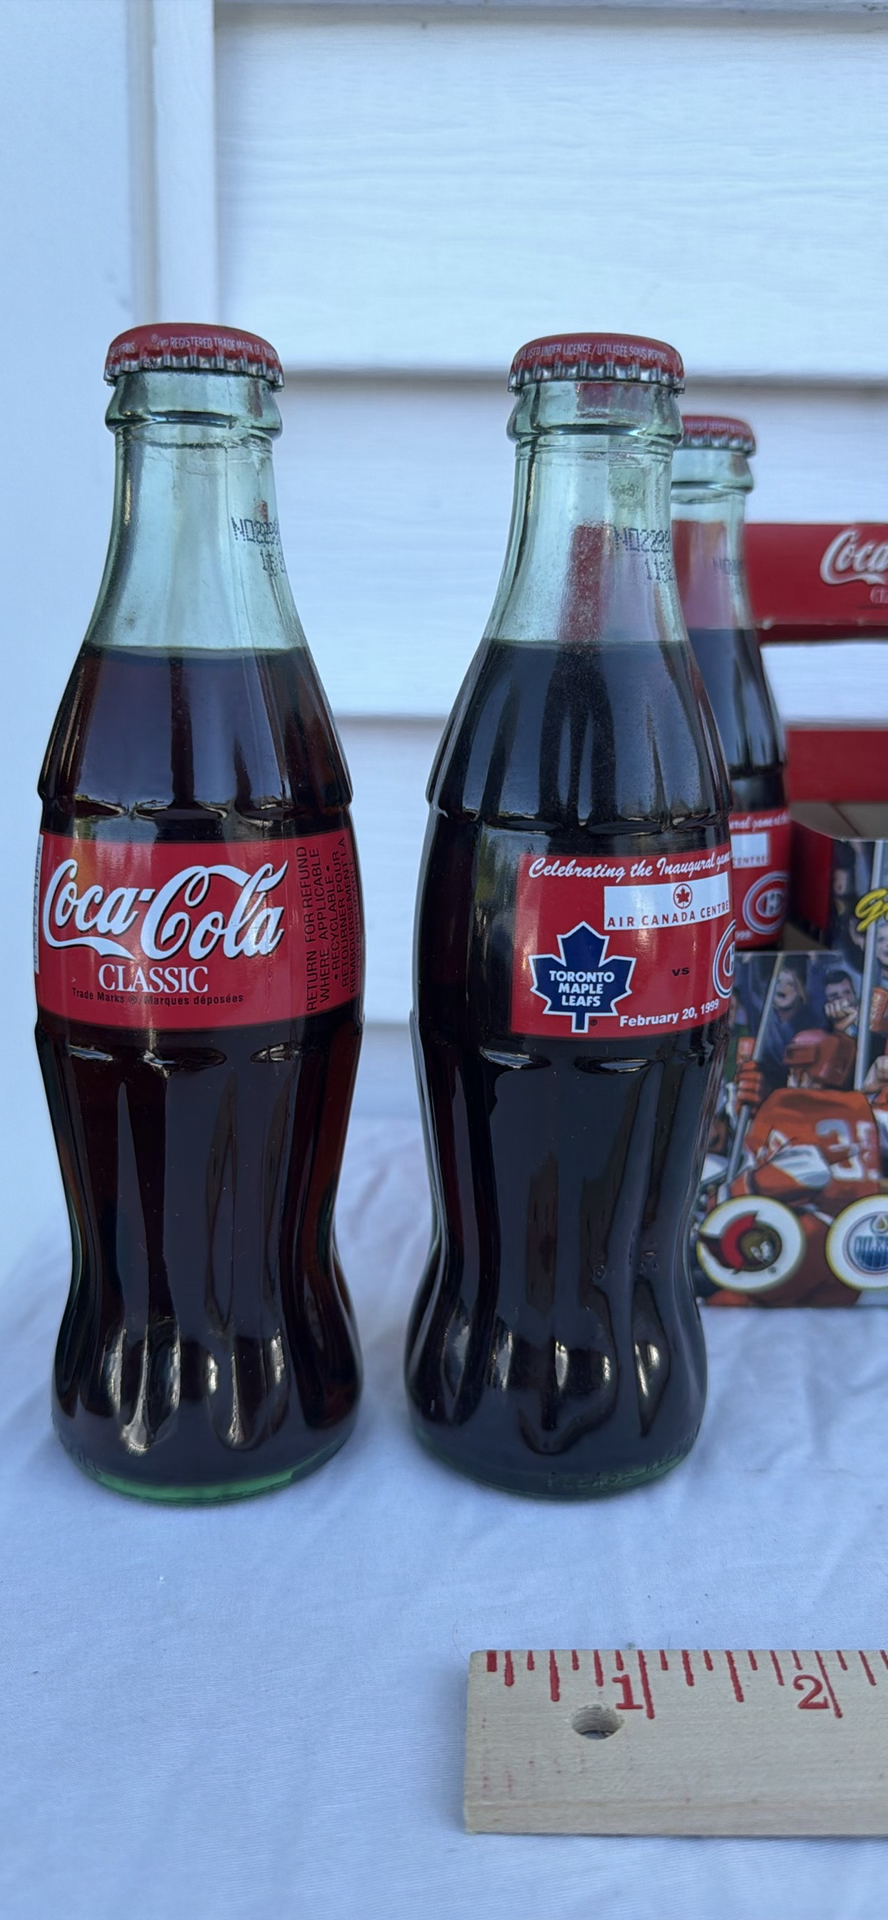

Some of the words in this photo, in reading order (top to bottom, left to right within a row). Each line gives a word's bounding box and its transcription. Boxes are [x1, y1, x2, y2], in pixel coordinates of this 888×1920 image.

[169, 336, 213, 350] REGISTERED
[214, 337, 235, 351] TRADE
[541, 344, 561, 356] UNDER
[338, 837, 346, 856] LA
[296, 847, 313, 908] REFUND
[332, 851, 344, 893] POUR
[528, 857, 626, 883] Celebrating
[630, 858, 654, 878] the
[656, 851, 715, 878] Inaugural
[716, 851, 730, 872] gam
[309, 848, 329, 940] APPLICABLE
[43, 859, 288, 961] Coca-Cola
[325, 875, 340, 970] RECYCLABLE
[607, 916, 635, 928] AIR
[641, 911, 696, 926] CANADA
[700, 900, 729, 919] CENTRE
[304, 913, 316, 943] FOR
[339, 898, 349, 987] RETOURNER
[98, 964, 208, 993] CLASSIC
[305, 950, 318, 1011] RETURN
[320, 948, 331, 1003] WHERE
[549, 970, 615, 983] TORONTO
[558, 983, 604, 995] MAPLE
[72, 987, 94, 1000] Trade
[97, 991, 125, 1004] Marks
[193, 993, 244, 1007] déposées
[561, 995, 601, 1007] LEAFS
[619, 1011, 679, 1028] February
[682, 1006, 697, 1021] 20,
[700, 998, 719, 1014] 1999
[612, 1674, 643, 1709] 1
[793, 1674, 829, 1709] 2
